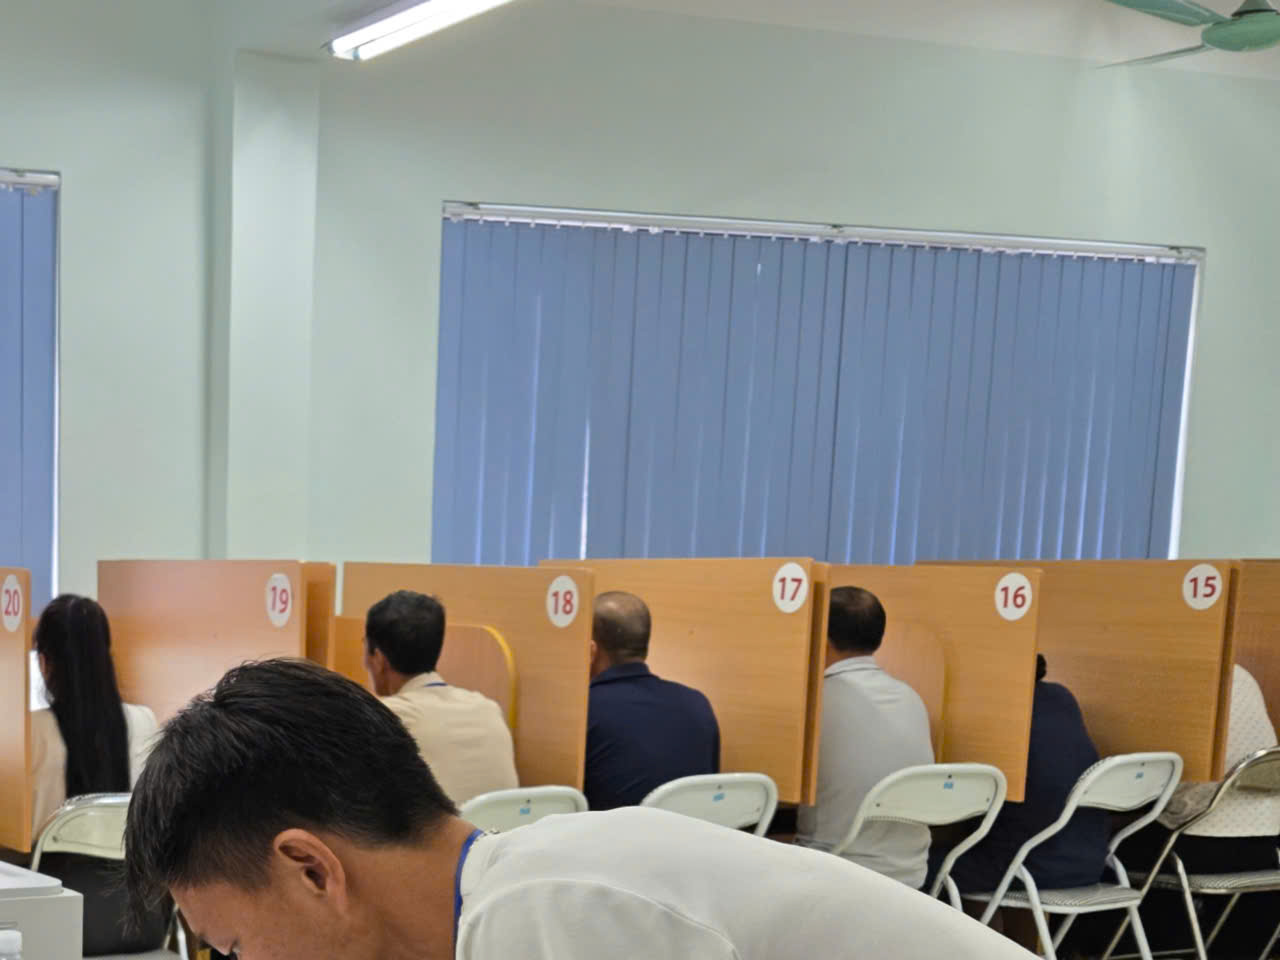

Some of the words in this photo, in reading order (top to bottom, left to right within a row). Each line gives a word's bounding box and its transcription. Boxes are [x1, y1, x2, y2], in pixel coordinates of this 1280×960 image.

[778, 576, 803, 601] 17
[1000, 585, 1027, 609] 16
[1189, 575, 1217, 598] 15
[4, 588, 20, 616] 20
[271, 586, 289, 613] 19
[552, 590, 574, 615] 18
